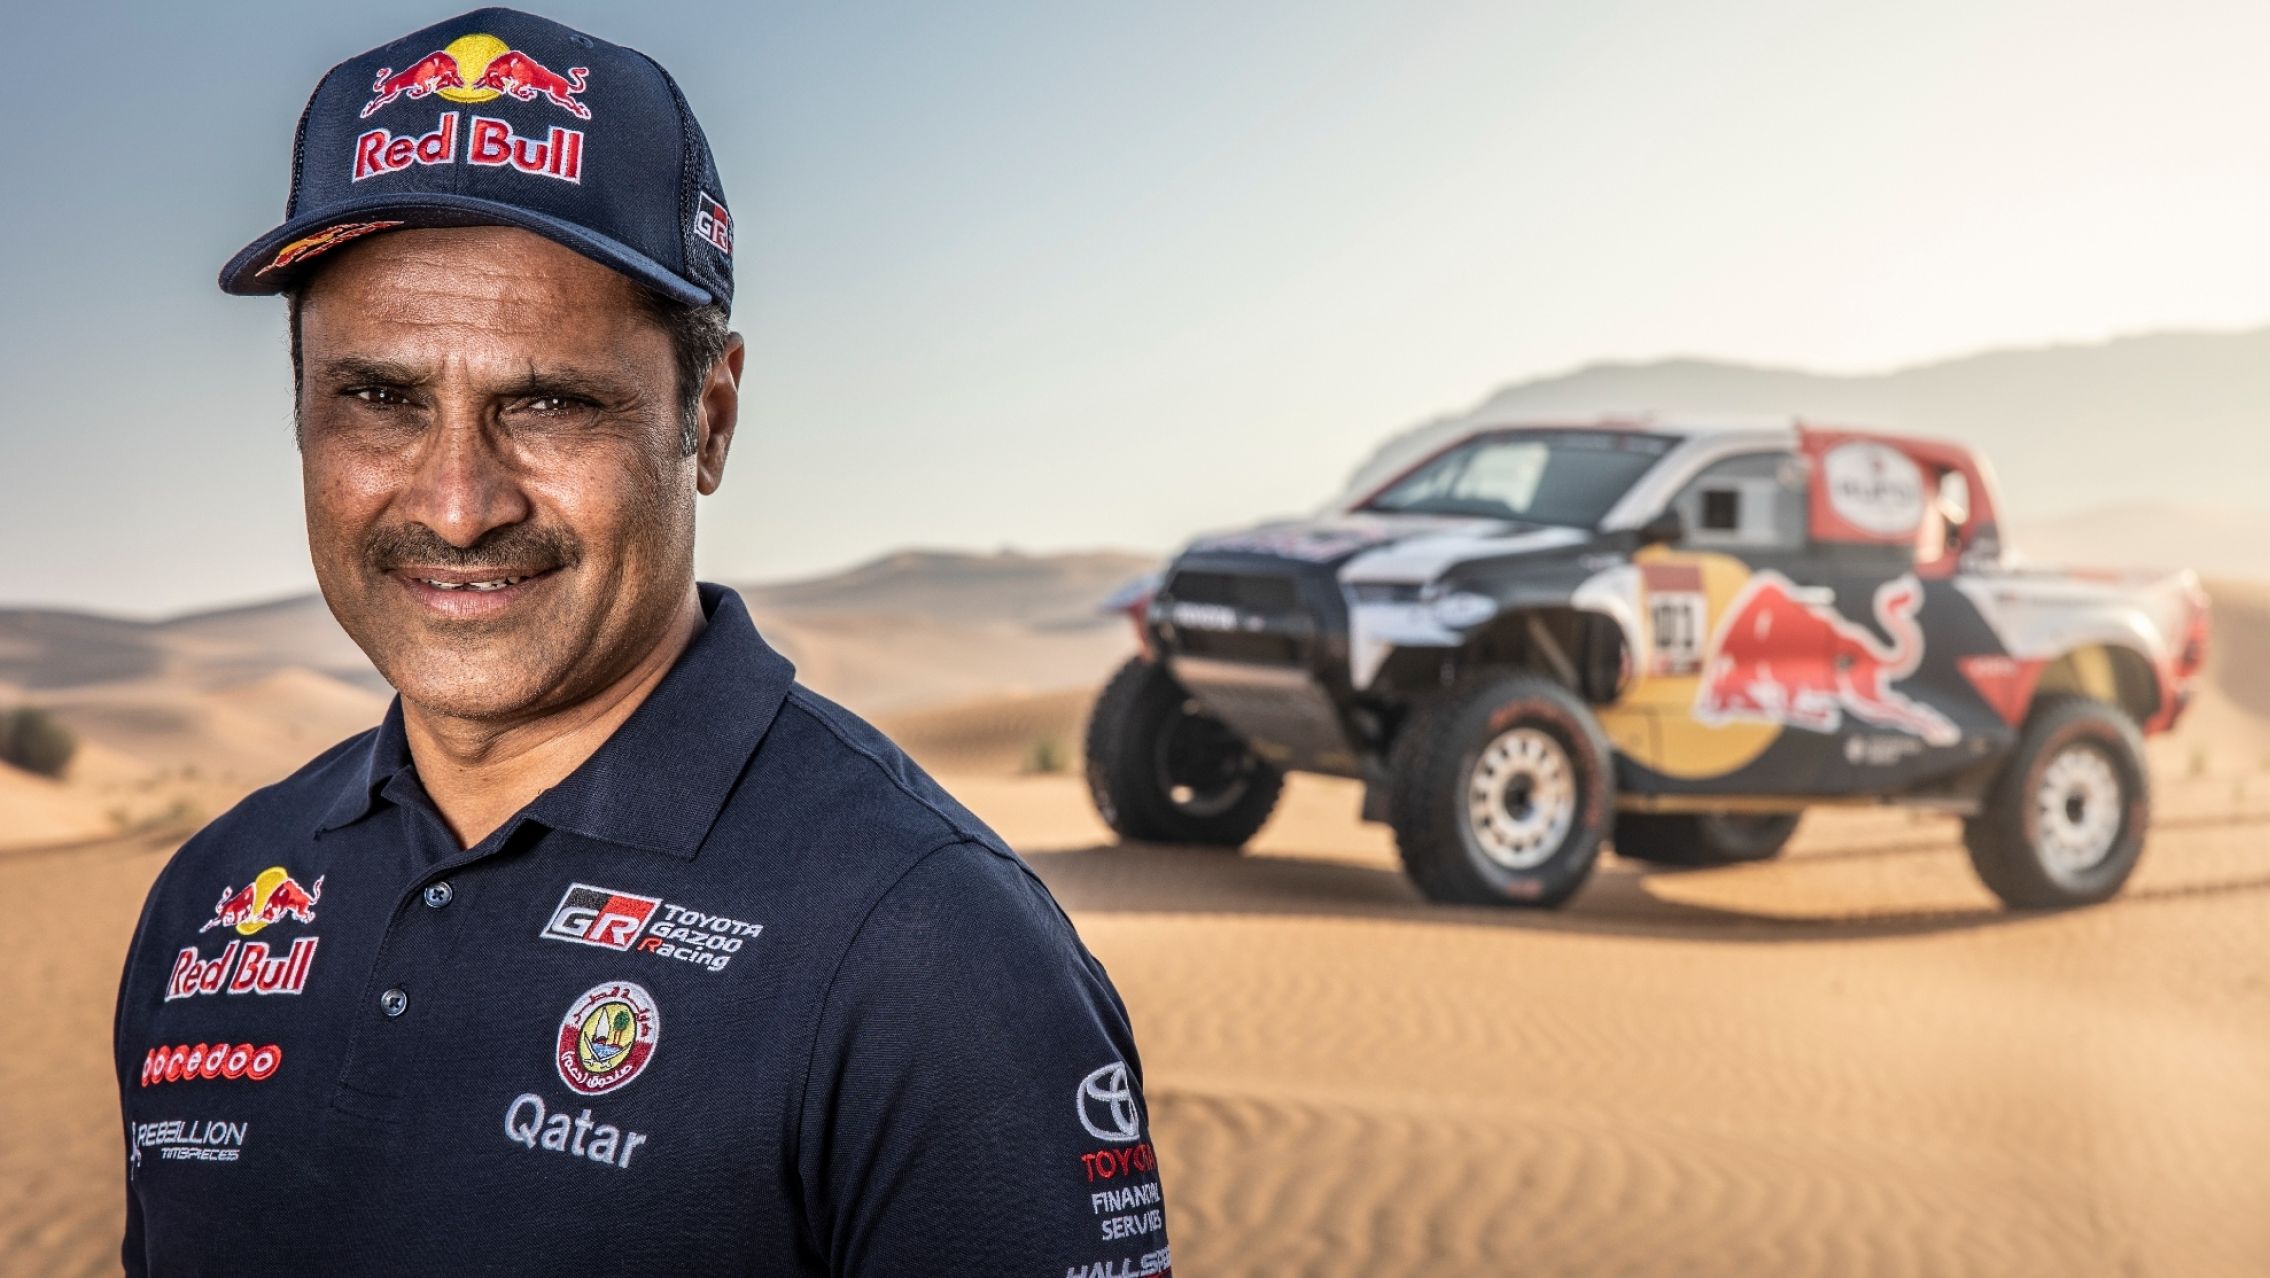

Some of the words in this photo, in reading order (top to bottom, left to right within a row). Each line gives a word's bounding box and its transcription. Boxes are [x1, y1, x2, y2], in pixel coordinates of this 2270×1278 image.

[352, 111, 458, 183] Red
[467, 115, 585, 184] Bull
[551, 906, 640, 946] GR
[649, 921, 743, 953] GAZOO
[664, 903, 763, 938] TOYOTA
[164, 940, 240, 1001] Red
[227, 937, 319, 995] Bull
[637, 937, 731, 972] Racing
[142, 1043, 280, 1086] ooredoo
[138, 1120, 248, 1146] REBELLION
[504, 1092, 647, 1169] Qatar
